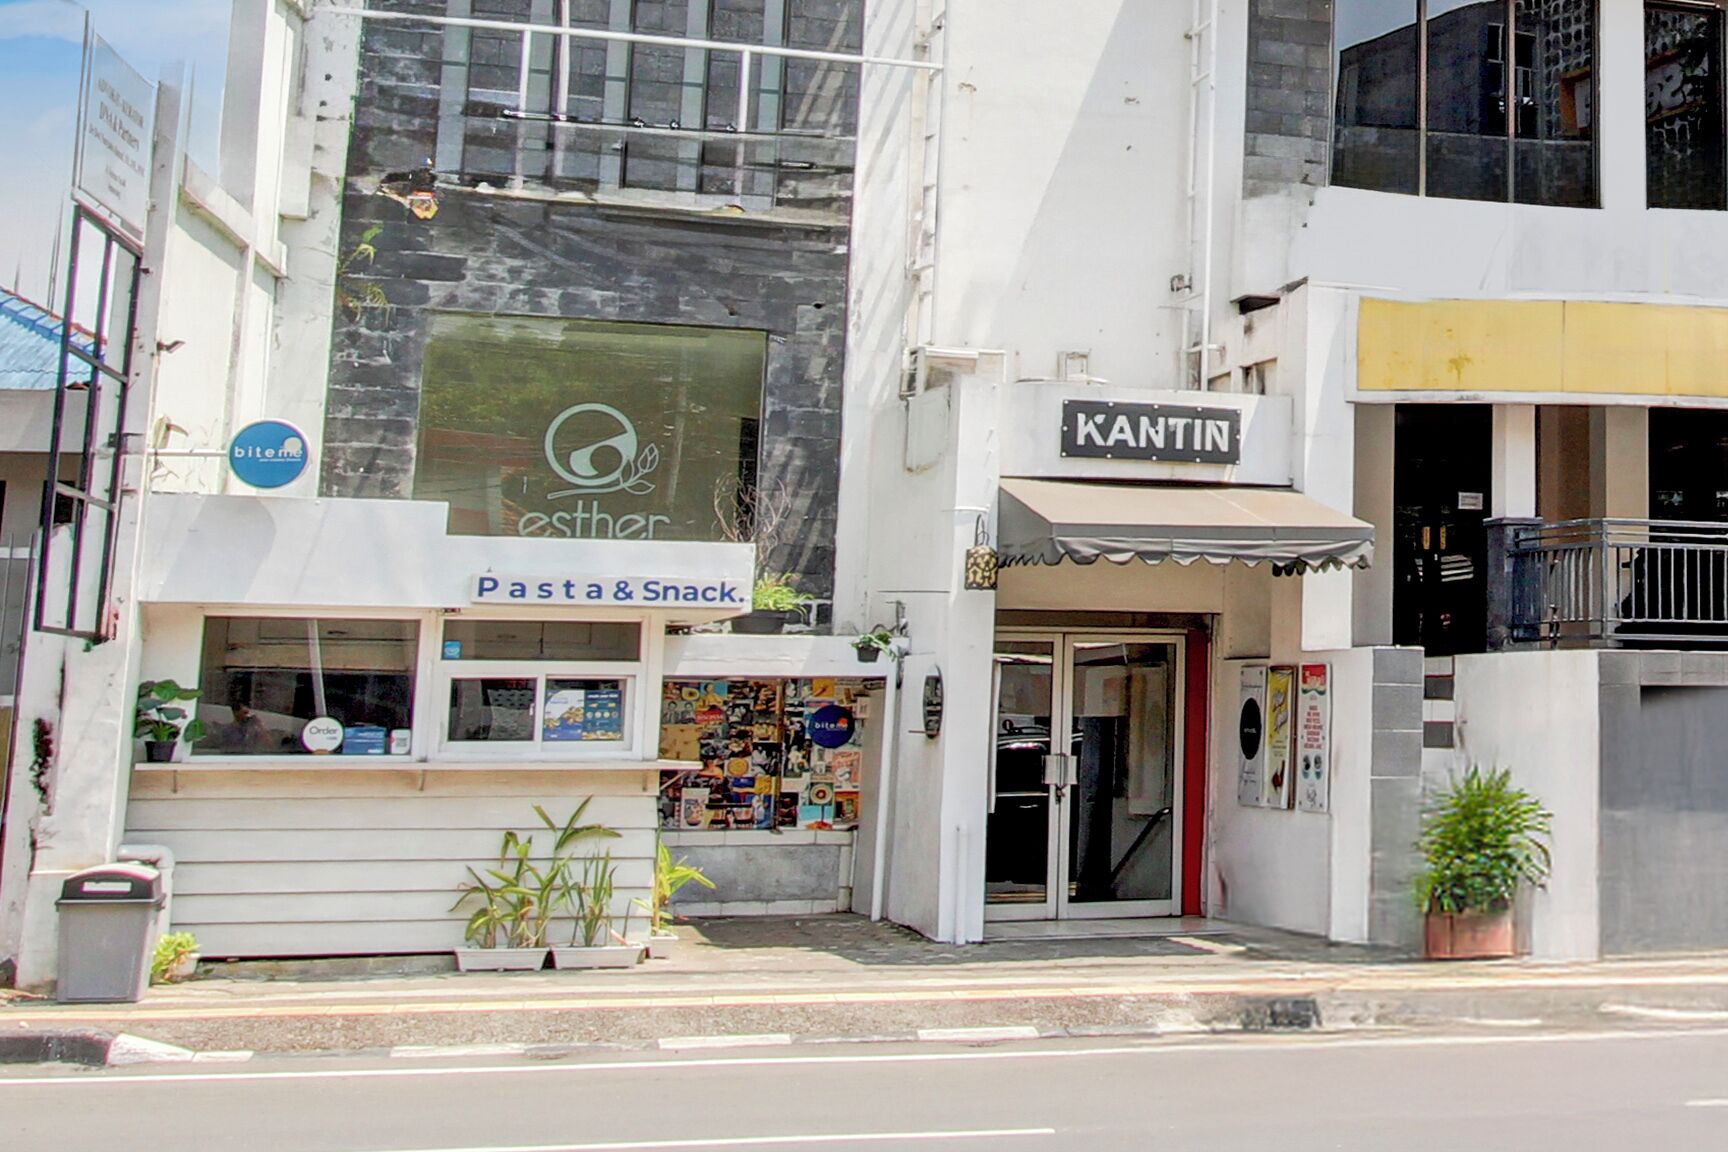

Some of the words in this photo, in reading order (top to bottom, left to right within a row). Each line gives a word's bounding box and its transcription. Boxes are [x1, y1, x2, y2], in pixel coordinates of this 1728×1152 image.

[1076, 412, 1230, 453] KANTIN
[517, 499, 671, 539] esther
[476, 576, 604, 600] Pasta
[612, 579, 635, 601] &
[642, 580, 746, 604] Snack.
[308, 725, 339, 736] Order
